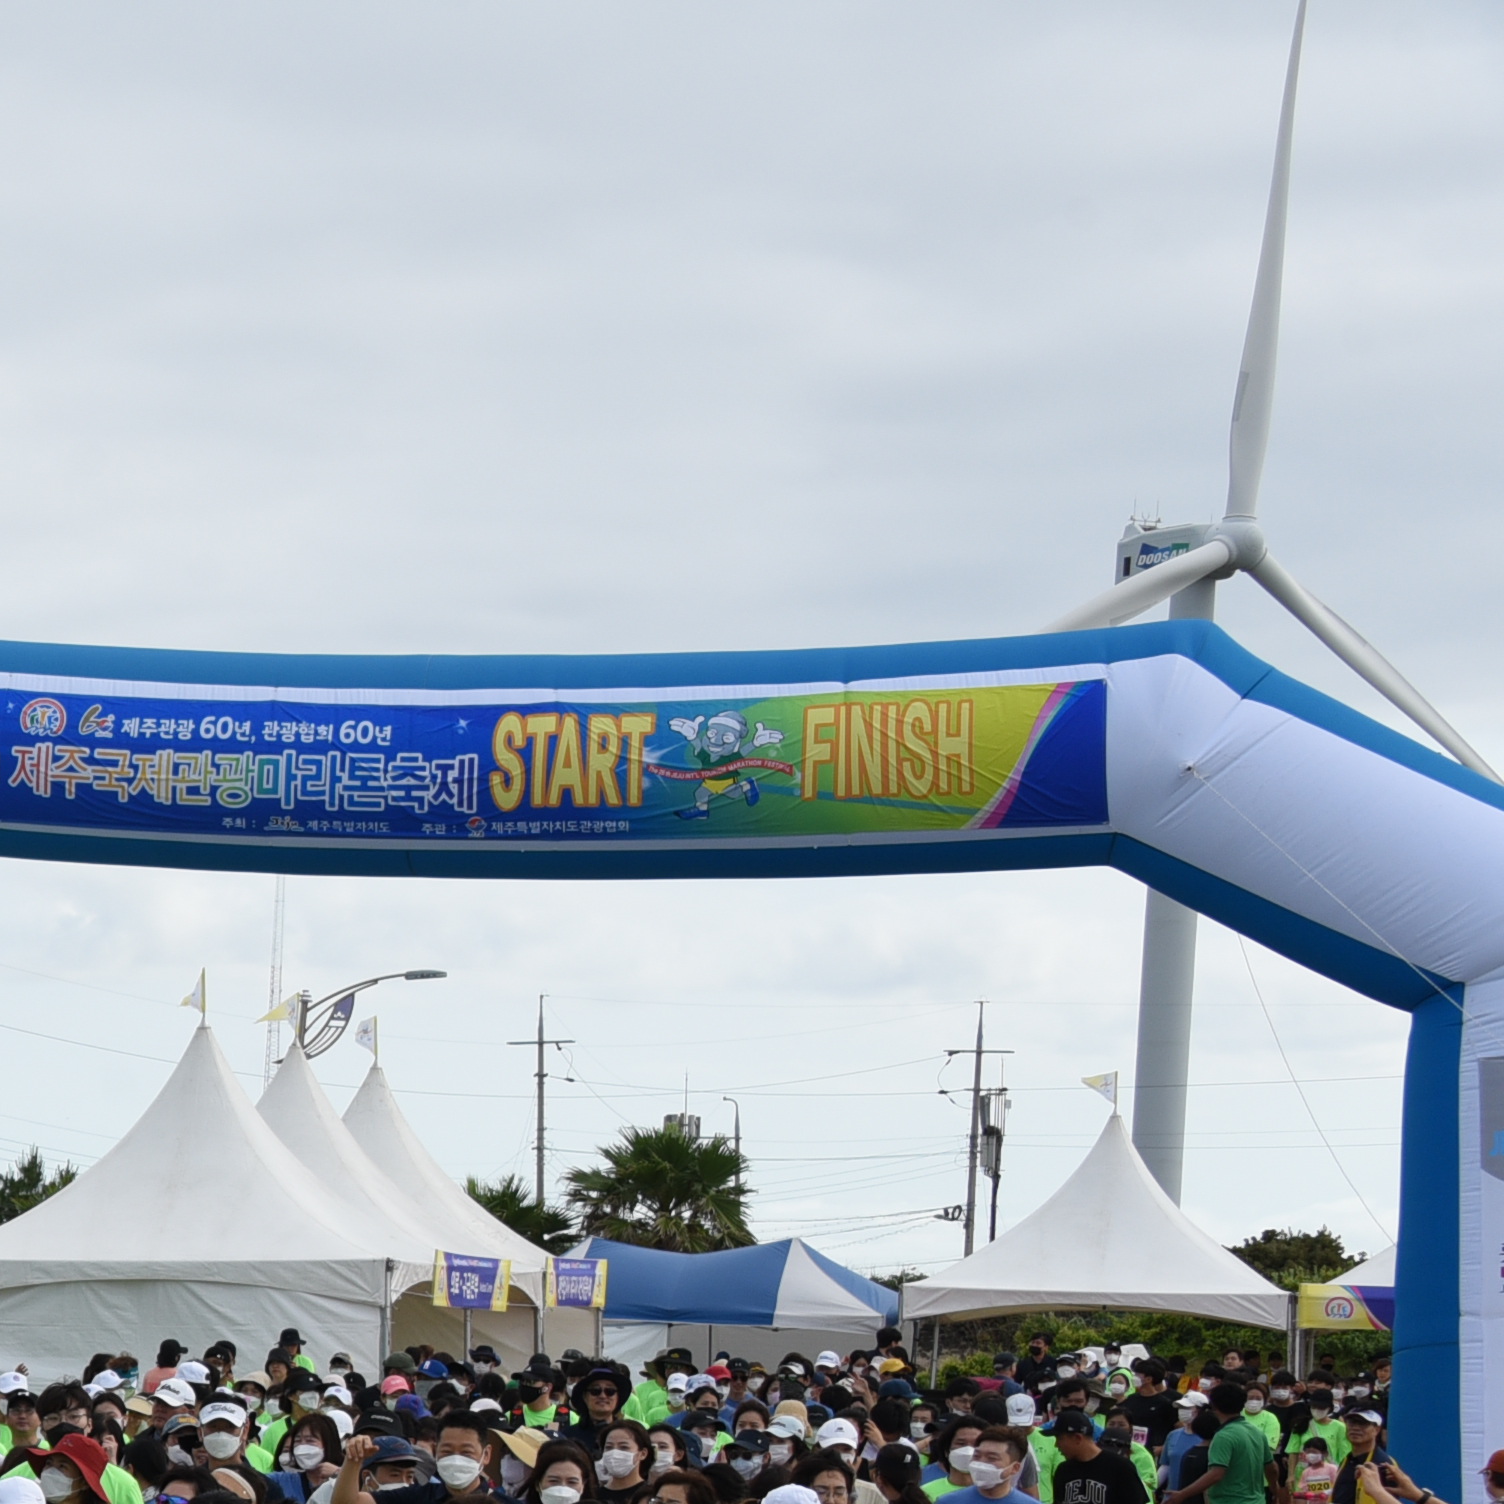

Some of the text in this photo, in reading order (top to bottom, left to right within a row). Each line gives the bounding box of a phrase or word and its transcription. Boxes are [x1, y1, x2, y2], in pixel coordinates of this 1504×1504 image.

[121, 717, 194, 741] 제주관광
[260, 719, 334, 745] 관광협회
[339, 720, 392, 747] 60년
[800, 697, 977, 803] FINISH
[7, 742, 478, 814] 제주국제관광마라톤축제
[490, 711, 656, 813] START
[306, 818, 390, 833] 제주특별자치도
[491, 819, 630, 835] 제주특별자치도관광협회
